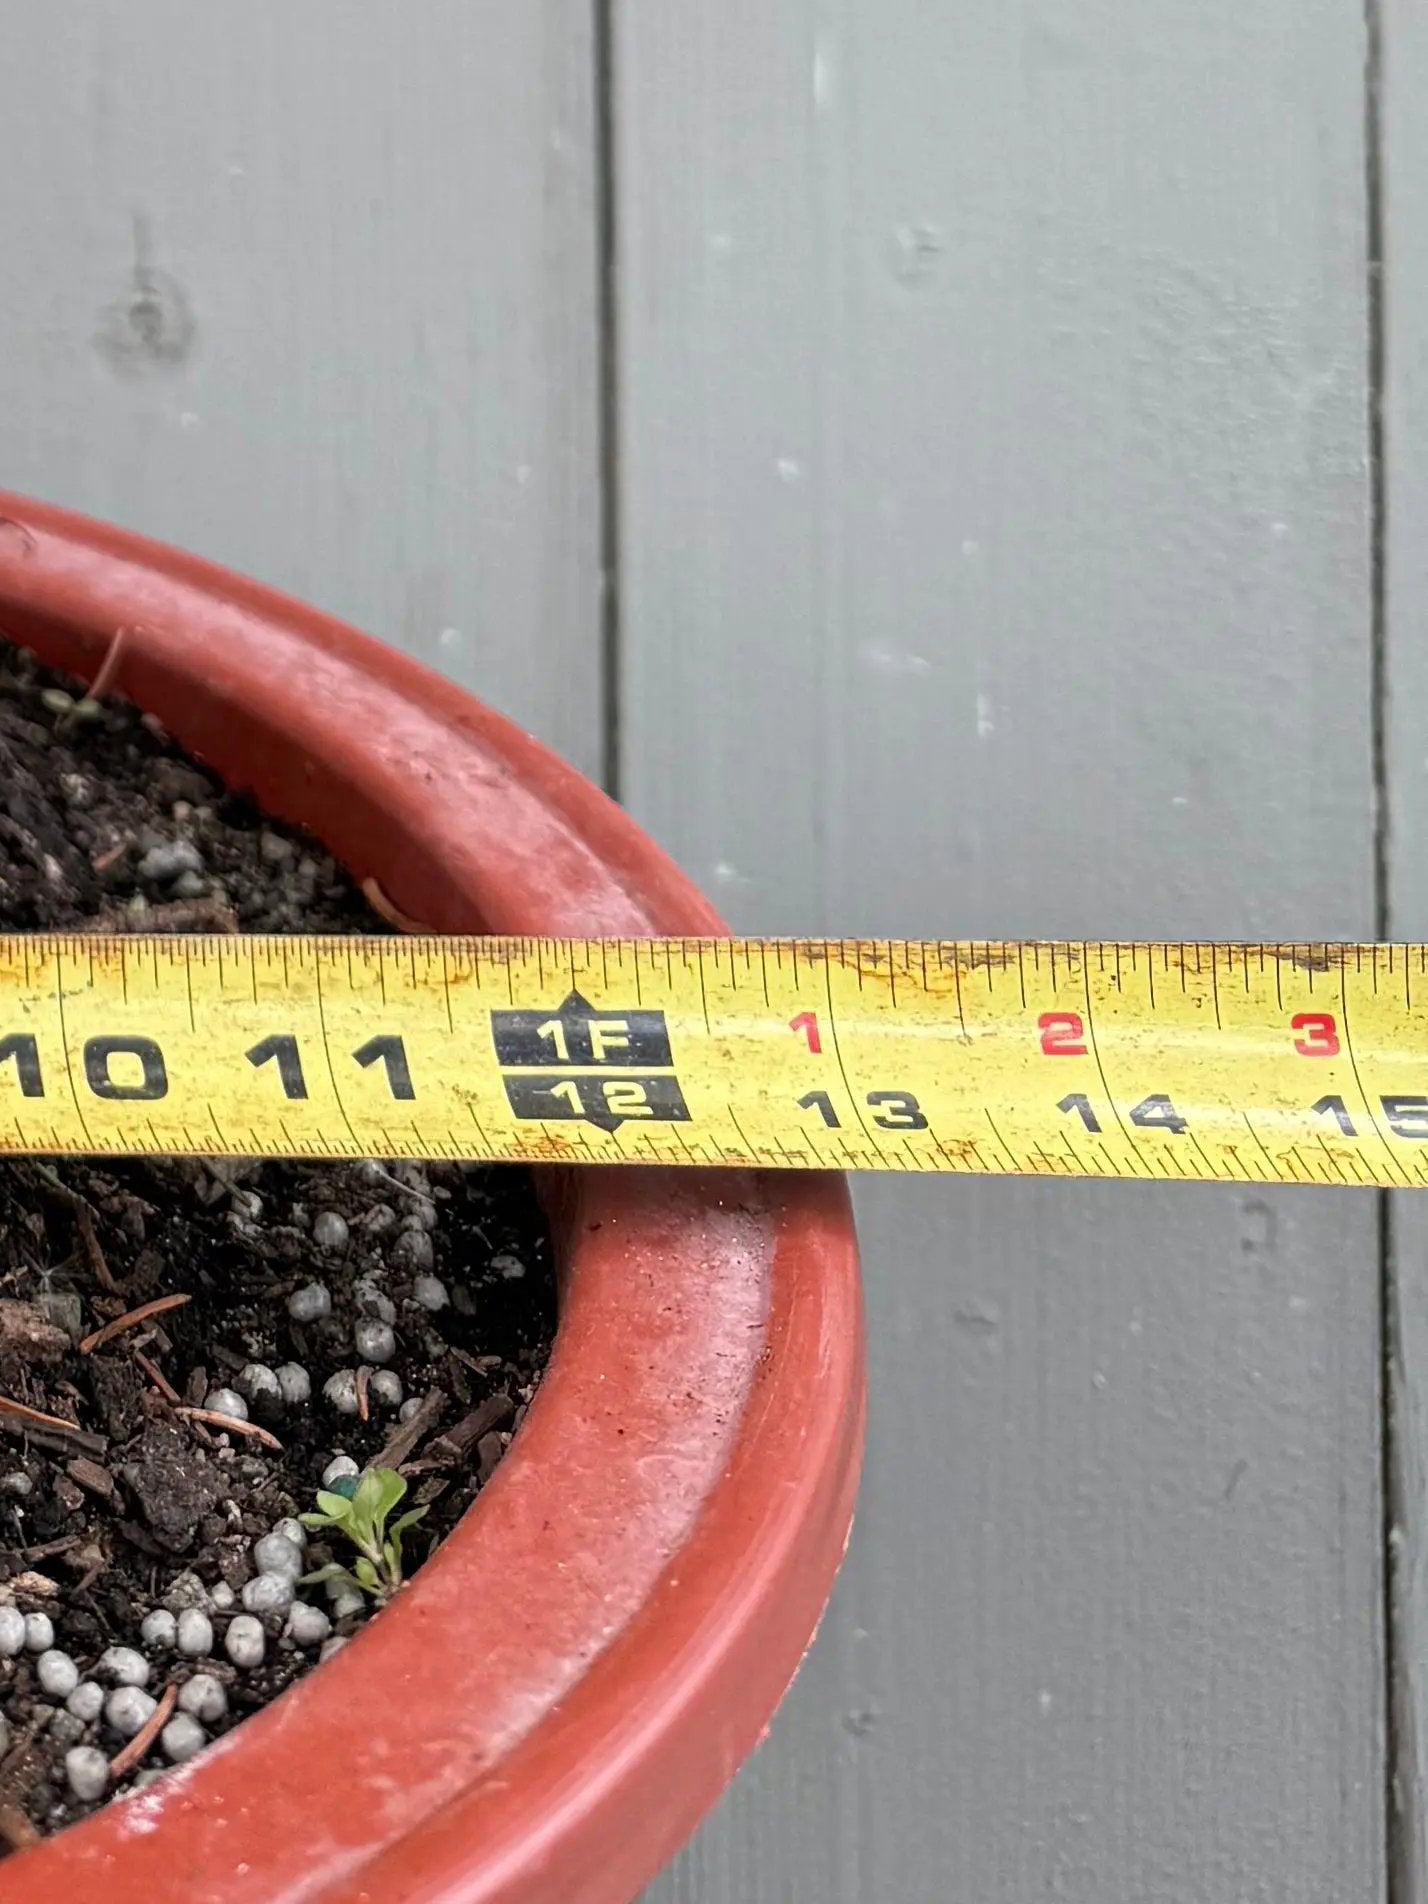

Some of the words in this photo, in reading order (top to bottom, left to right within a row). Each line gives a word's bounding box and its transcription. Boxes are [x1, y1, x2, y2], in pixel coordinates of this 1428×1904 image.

[788, 1011, 823, 1055] 1
[1036, 1011, 1090, 1057] 2
[1289, 1012, 1342, 1057] 3
[245, 1034, 417, 1101] 11
[549, 1080, 655, 1116] 12
[796, 1090, 930, 1130] 13
[1055, 1092, 1190, 1135] 14
[1309, 1094, 1428, 1139] 15
